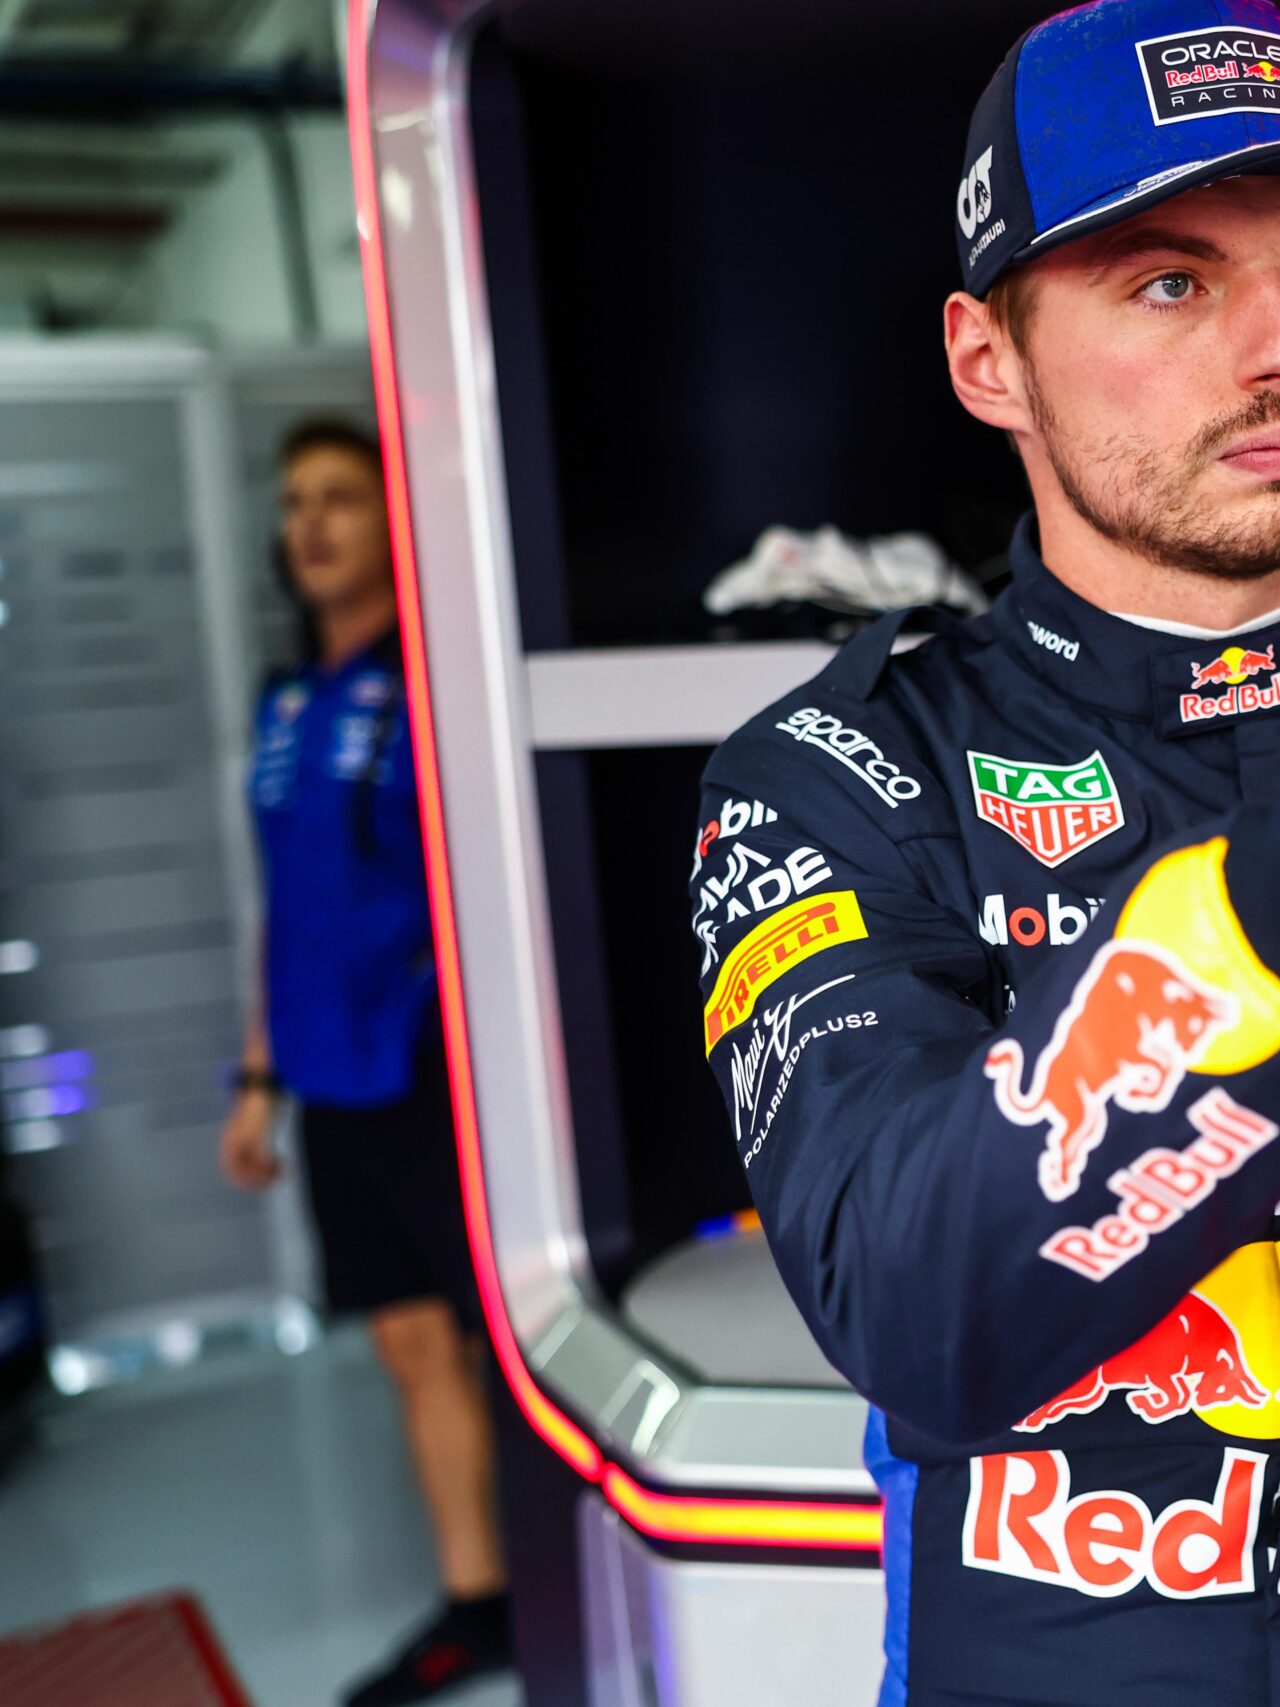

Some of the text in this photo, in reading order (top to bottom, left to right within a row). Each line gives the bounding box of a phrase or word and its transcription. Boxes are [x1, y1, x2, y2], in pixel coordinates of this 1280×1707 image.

[1165, 60, 1240, 88] Red Bull
[1180, 686, 1239, 723] Red
[784, 706, 922, 800] sparco
[981, 761, 1100, 800] TAG
[985, 799, 1113, 858] HEUER
[978, 892, 1106, 947] Mob
[706, 901, 841, 1046] PIRELLI
[1039, 1086, 1280, 1282] Red Bull
[962, 1447, 1270, 1600] Red
